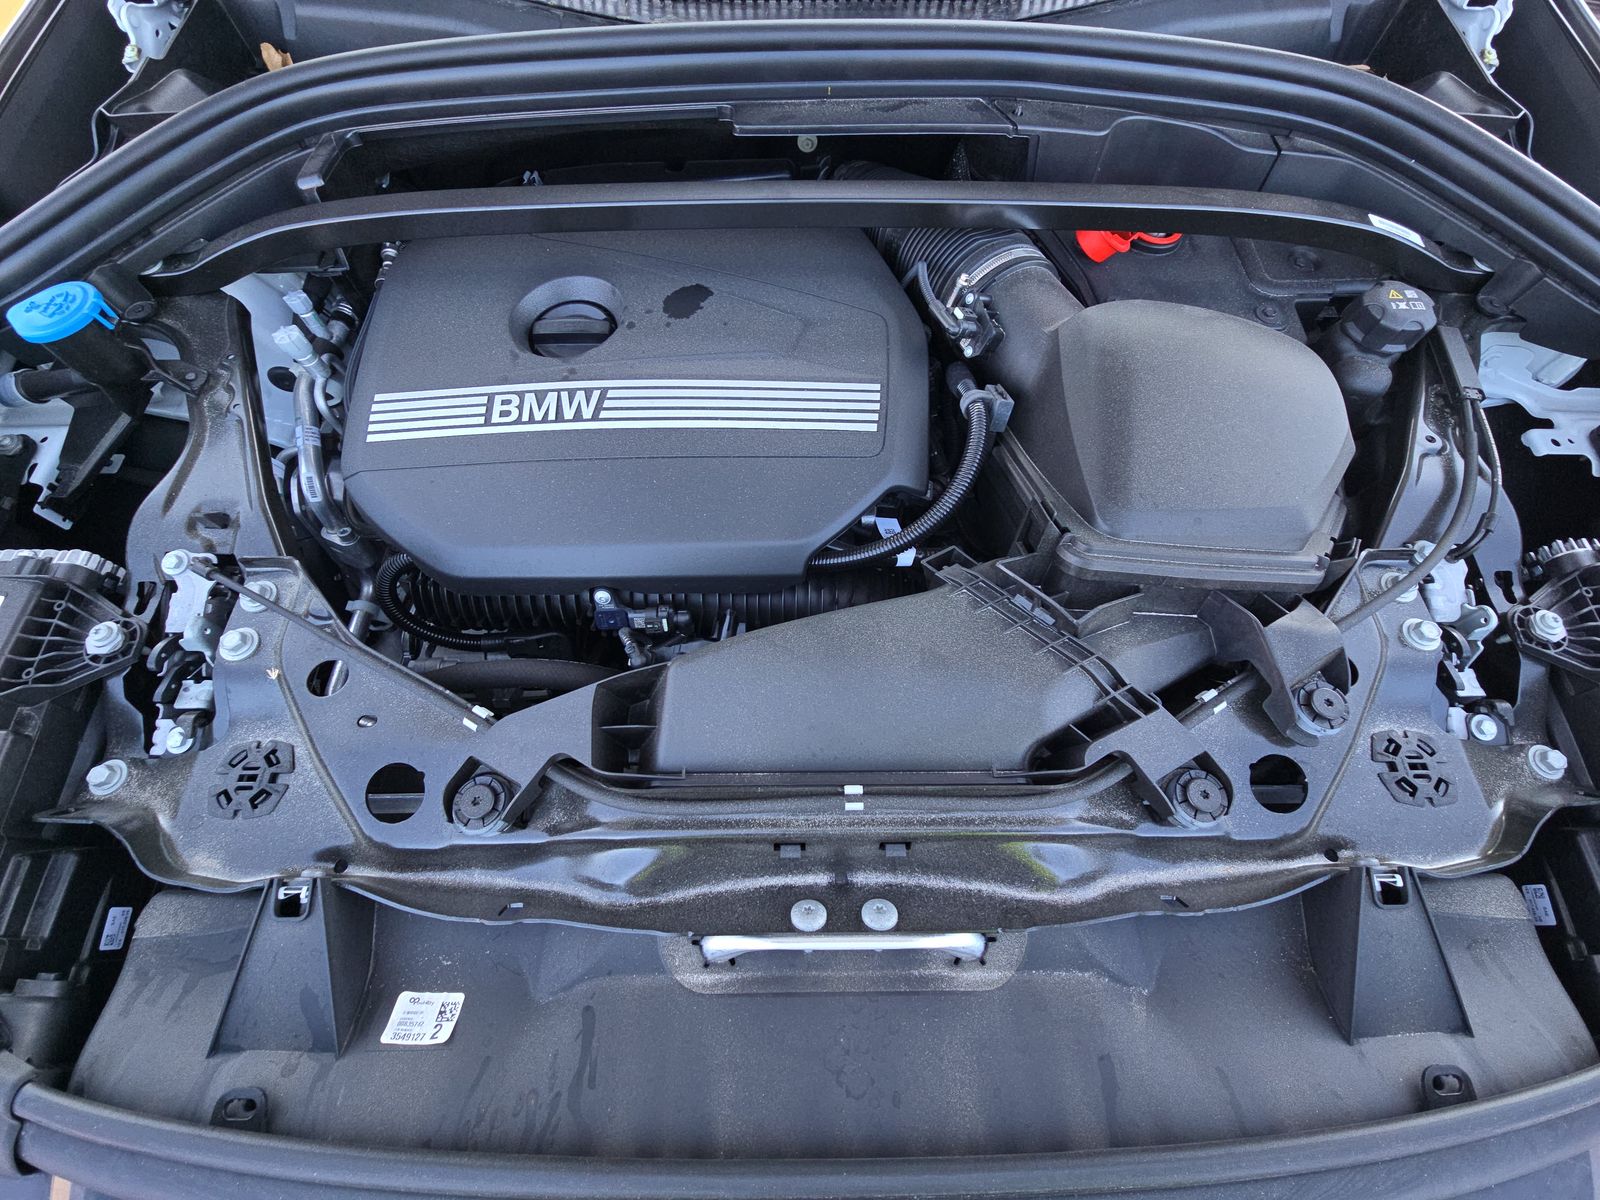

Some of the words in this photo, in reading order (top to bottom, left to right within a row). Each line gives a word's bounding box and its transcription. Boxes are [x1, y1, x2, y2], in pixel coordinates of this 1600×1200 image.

[491, 389, 602, 423] BMW
[389, 1032, 426, 1041] 3549127
[429, 1023, 443, 1040] 2
